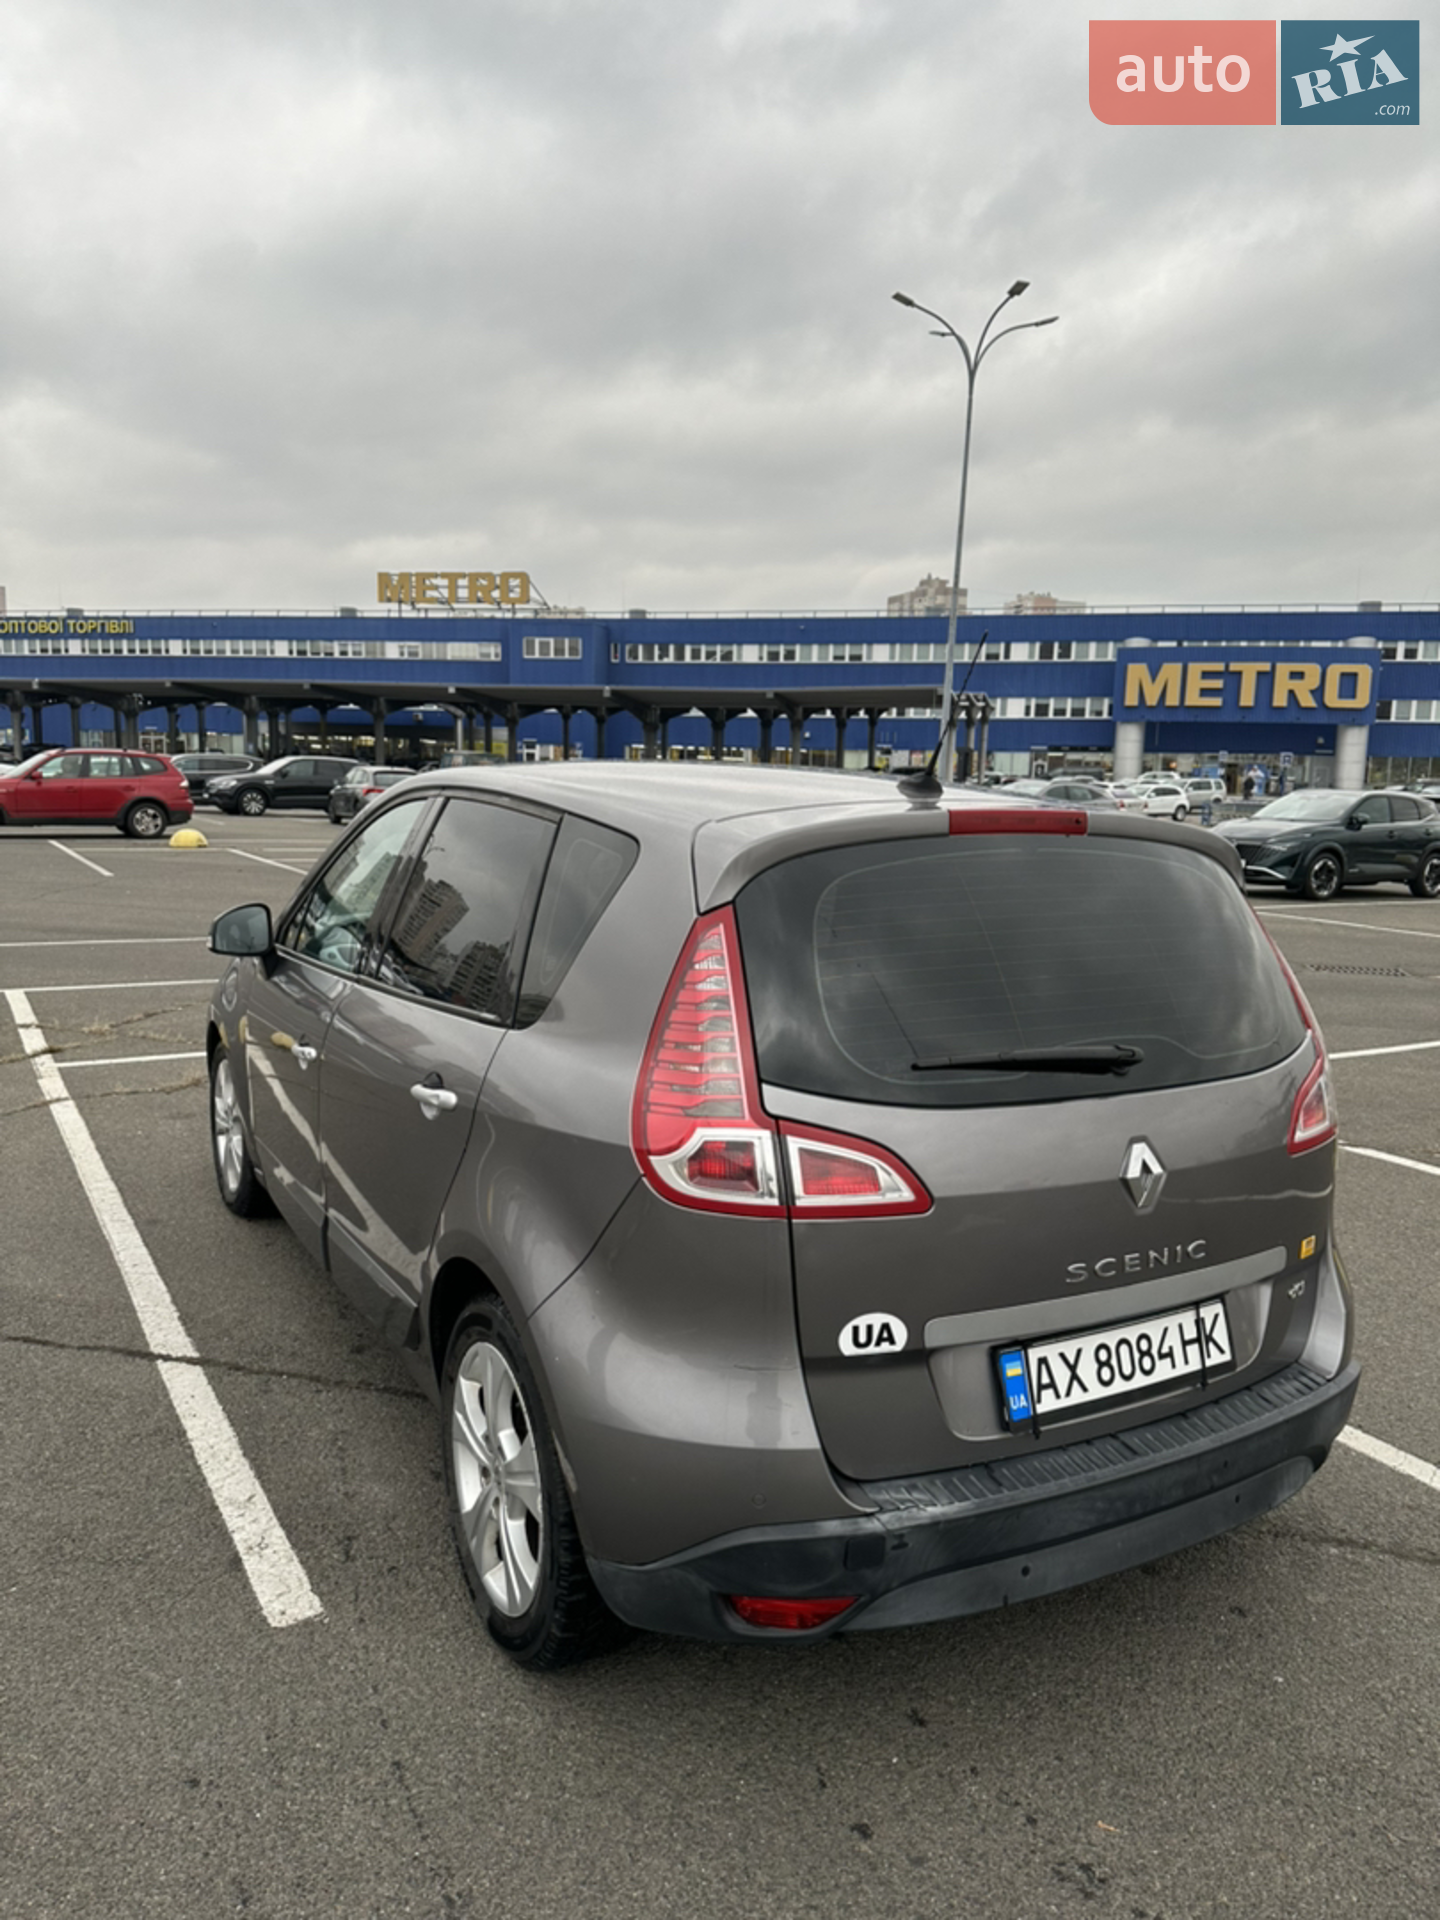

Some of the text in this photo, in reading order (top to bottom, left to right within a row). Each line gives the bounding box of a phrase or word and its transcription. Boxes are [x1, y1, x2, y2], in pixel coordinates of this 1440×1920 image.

[377, 571, 530, 604] METRO
[67, 619, 135, 634] ТОРГІВЛІ
[1124, 661, 1373, 709] METRO
[1065, 1239, 1207, 1283] SCENIC
[851, 1322, 897, 1350] UA
[1036, 1312, 1227, 1405] AX 8084 HK
[1009, 1393, 1029, 1410] UA
